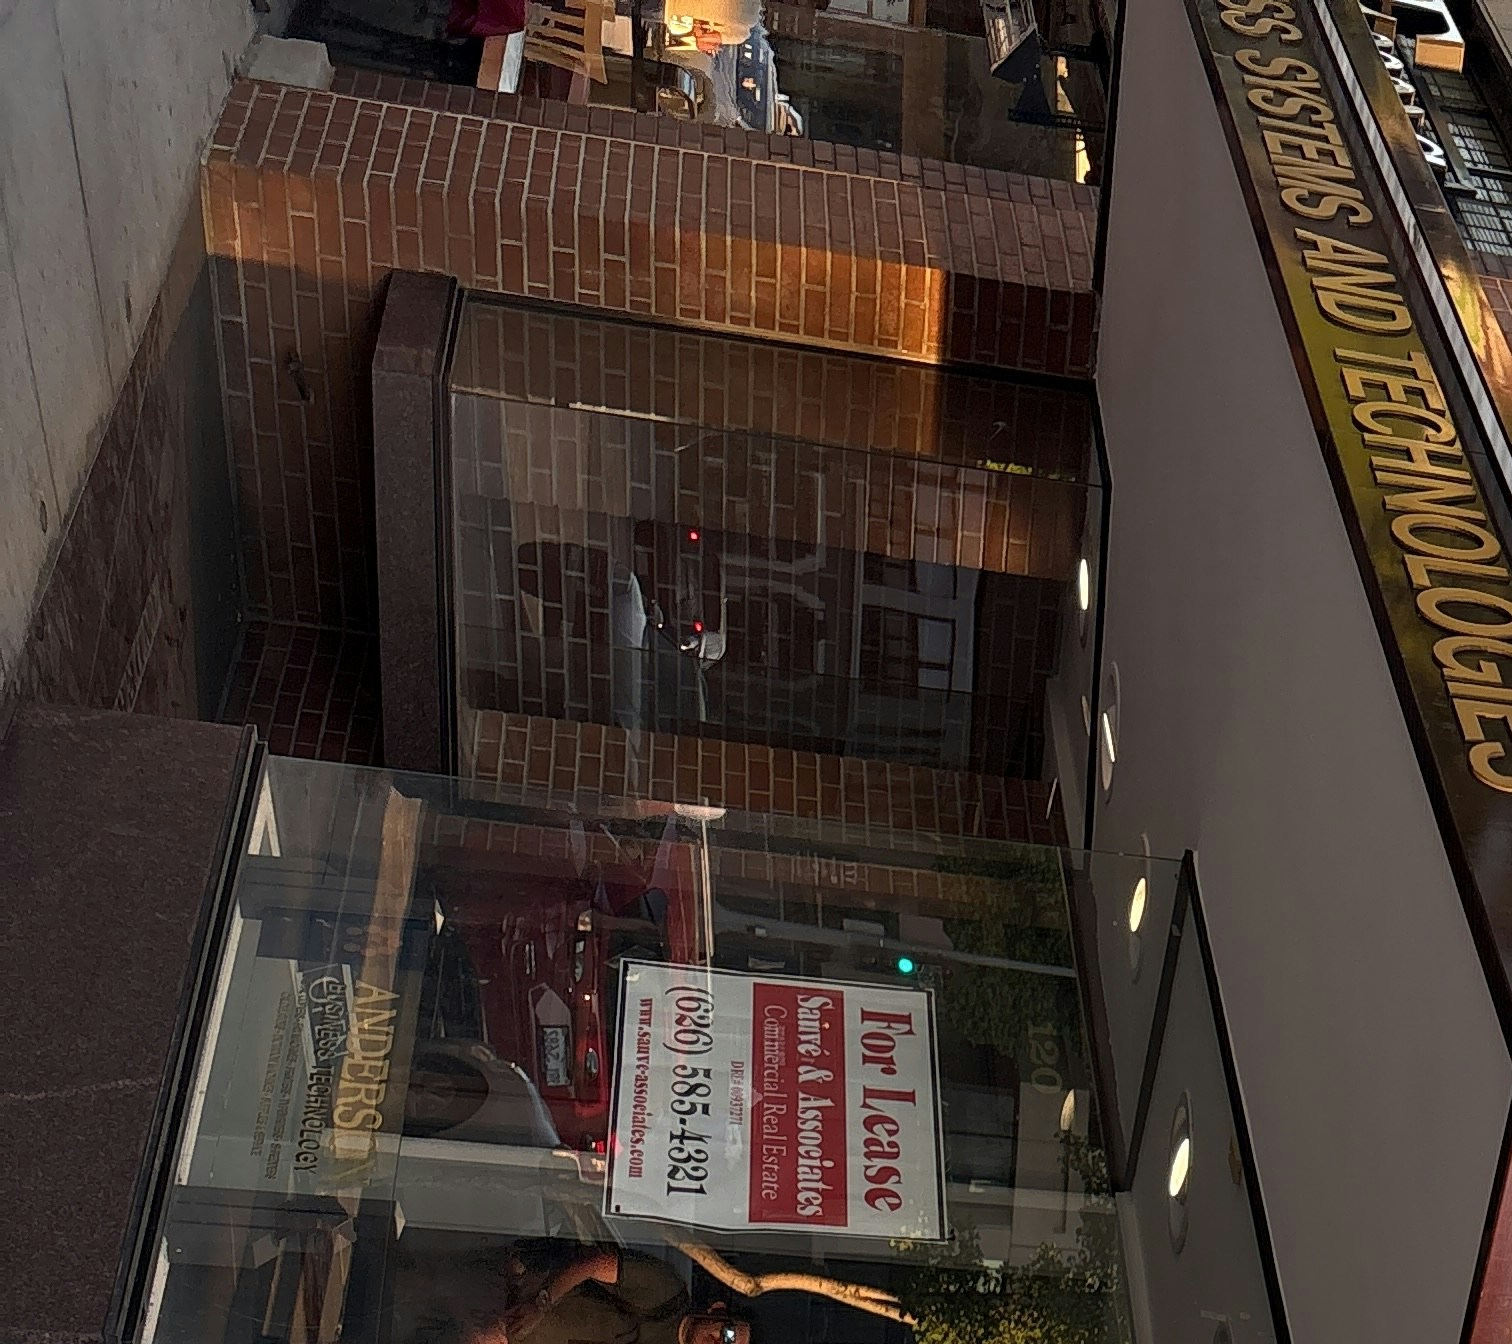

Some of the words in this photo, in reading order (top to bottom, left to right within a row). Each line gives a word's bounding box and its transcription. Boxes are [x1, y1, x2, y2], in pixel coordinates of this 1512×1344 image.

[1233, 48, 1375, 227] SYSTEMS
[1293, 228, 1414, 335] AND
[315, 982, 348, 1060] BUSINESS
[663, 986, 714, 1055] (626)
[762, 1005, 788, 1097] Commercial
[796, 994, 833, 1056] Sauvé
[860, 1007, 917, 1076] For
[1028, 1023, 1062, 1094] 120
[293, 1065, 335, 1174] TECHNOLOGY
[330, 979, 400, 1187] ANDERSON
[628, 998, 653, 1178] www.sauve-associates.com
[797, 1064, 834, 1084] &
[666, 1064, 713, 1196] 585-4321
[761, 1103, 787, 1141] Real
[796, 1091, 835, 1216] Associates
[859, 1085, 917, 1212] Lease
[760, 1144, 783, 1200] Estate
